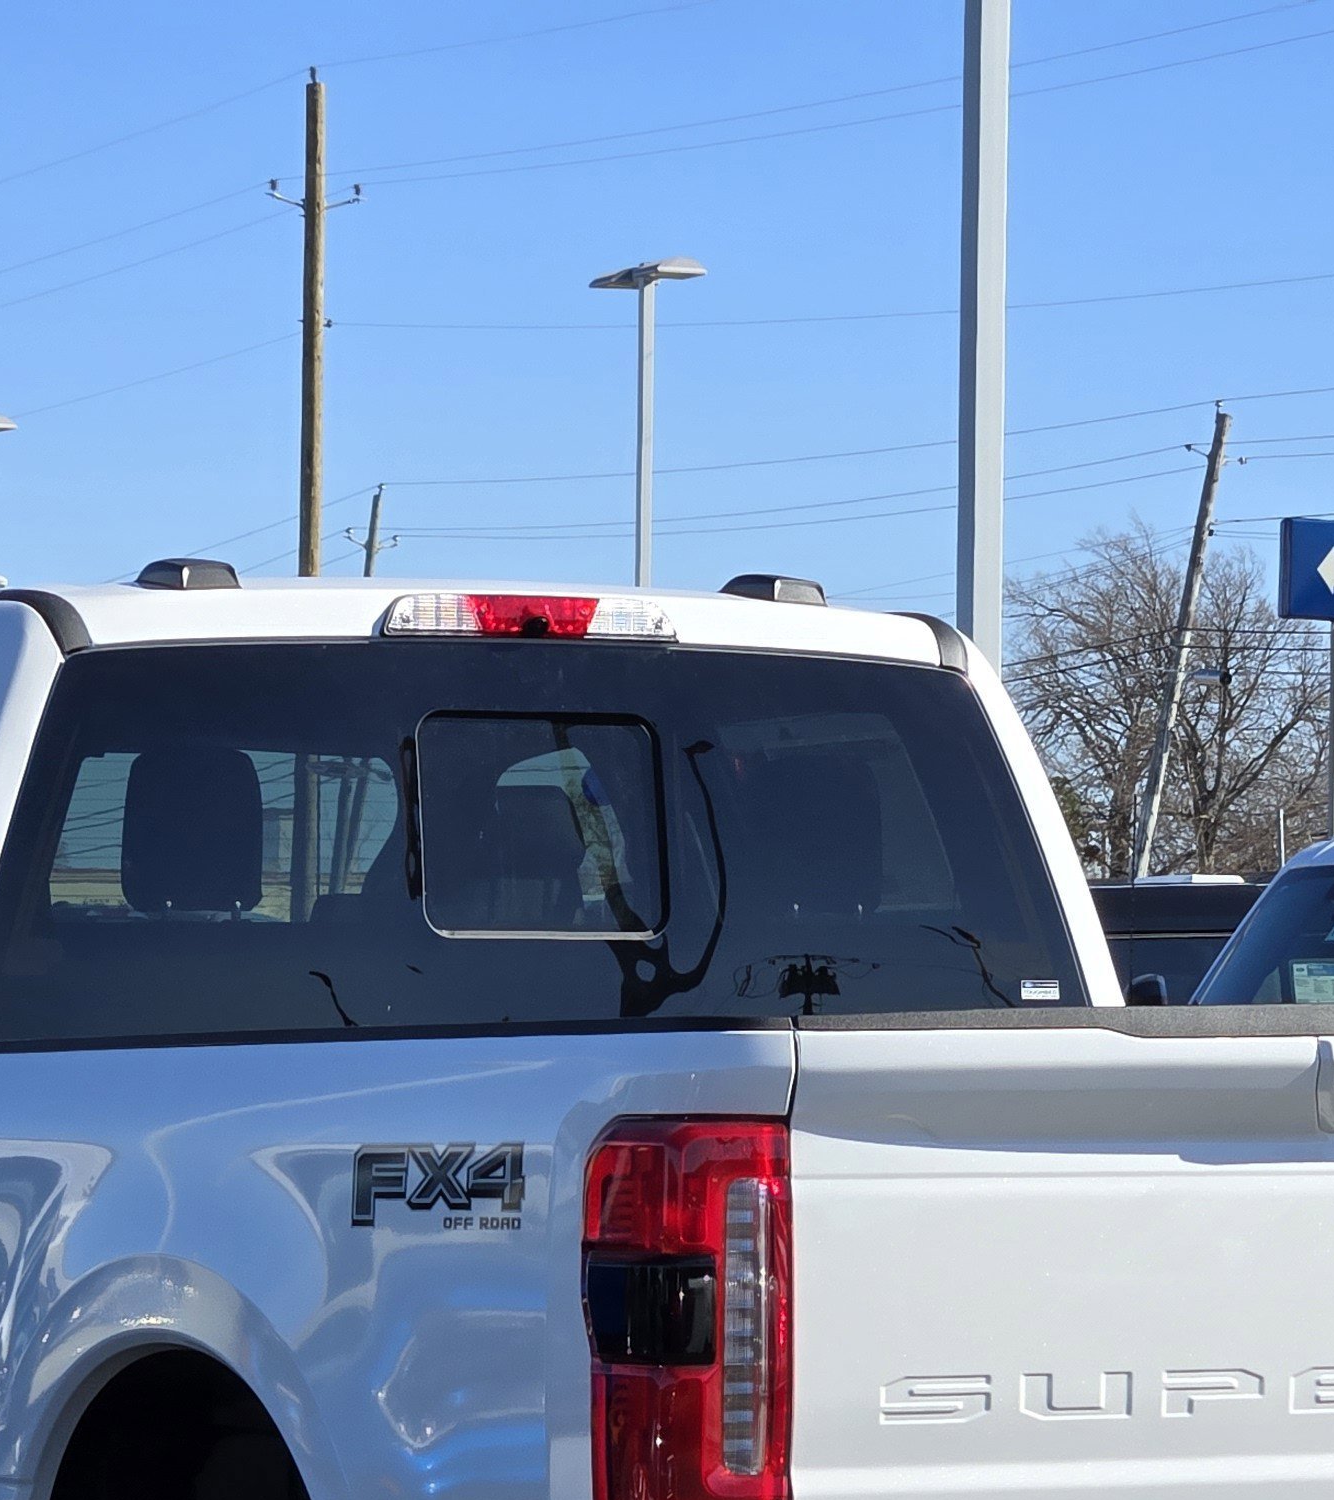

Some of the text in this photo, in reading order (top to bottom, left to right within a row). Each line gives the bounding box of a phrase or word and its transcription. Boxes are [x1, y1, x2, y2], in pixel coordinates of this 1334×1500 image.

[351, 1141, 526, 1227] FX4
[443, 1216, 521, 1230] OFF ROAD
